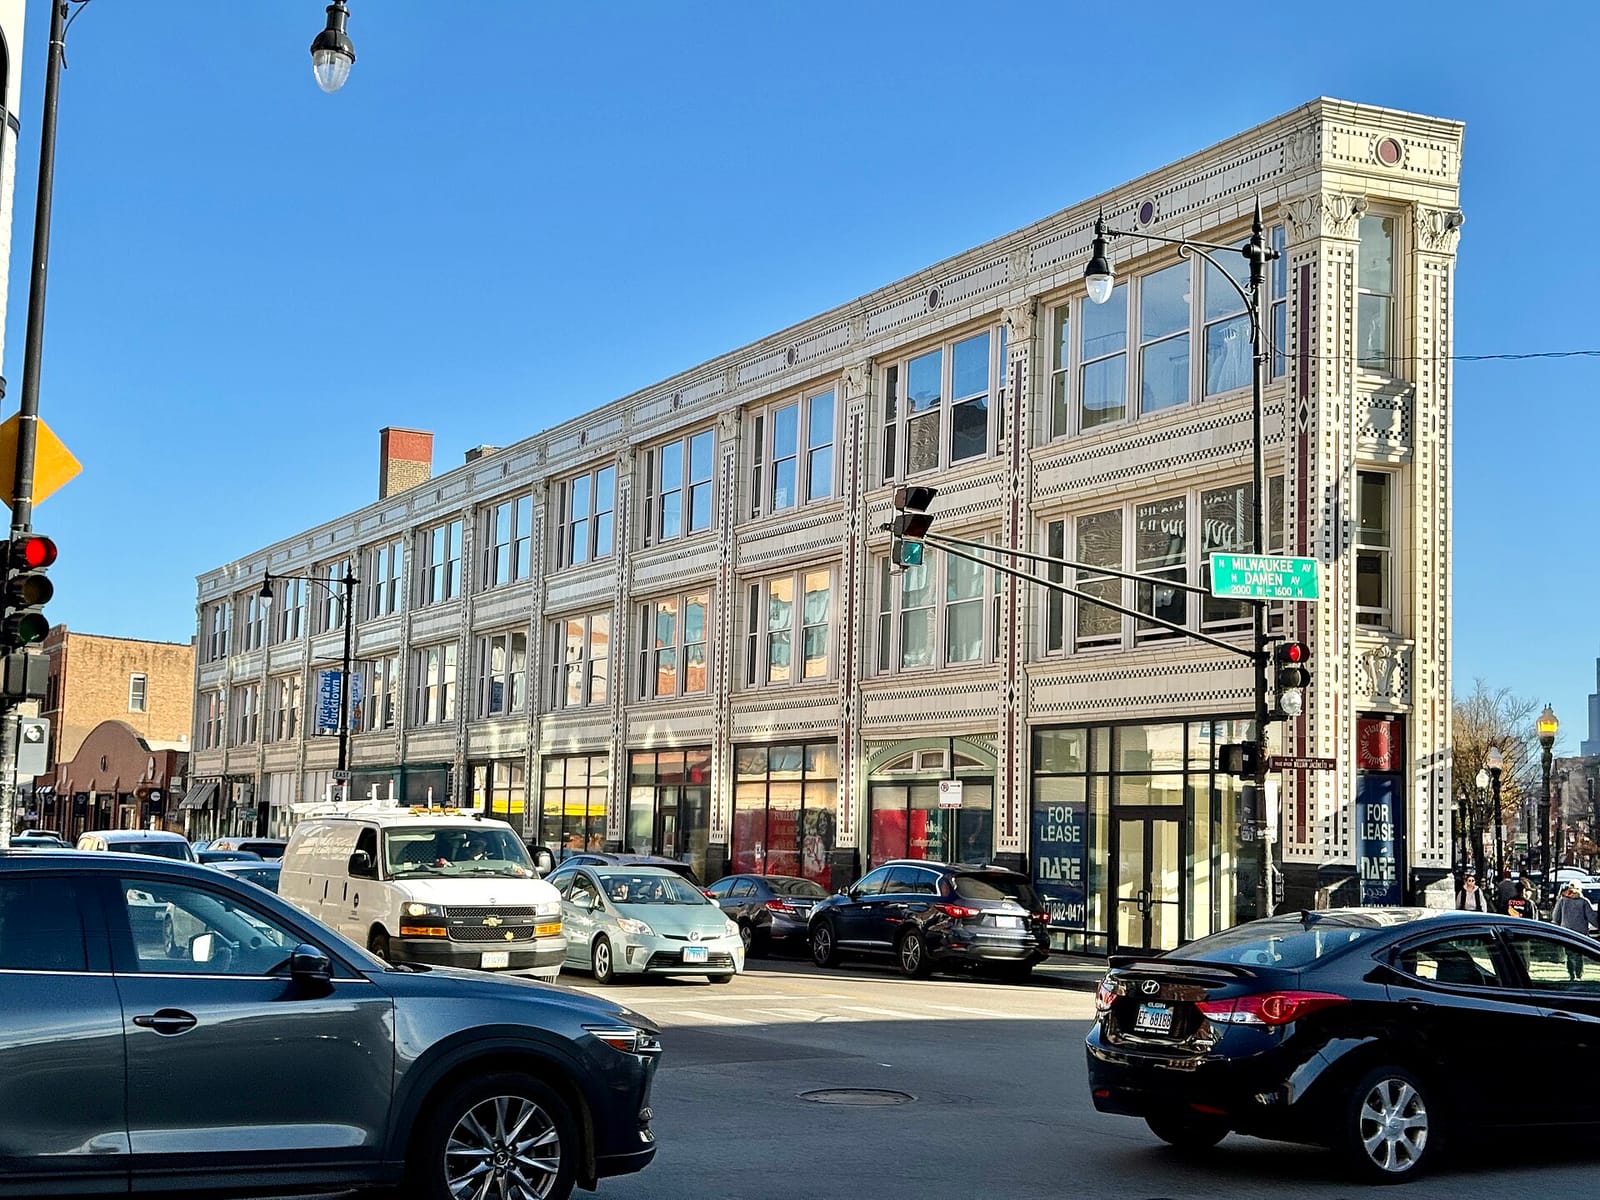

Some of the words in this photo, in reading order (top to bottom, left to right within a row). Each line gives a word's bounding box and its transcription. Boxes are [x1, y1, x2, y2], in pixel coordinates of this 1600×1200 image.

[1219, 559, 1225, 568] N
[1232, 558, 1294, 573] MILWAUKEE
[1301, 564, 1311, 573] AV
[1231, 573, 1238, 583] N
[1244, 572, 1283, 586] DAMEN
[1290, 575, 1300, 585] AV
[1231, 585, 1251, 594] 2000
[1275, 586, 1292, 596] 1600
[1297, 588, 1303, 597] N
[328, 679, 340, 725] Bucktown
[1047, 806, 1073, 824] FOR
[1367, 803, 1389, 822] FOR
[1040, 825, 1080, 842] LEASE
[1361, 823, 1395, 842] LEASE
[1138, 1011, 1148, 1025] EF
